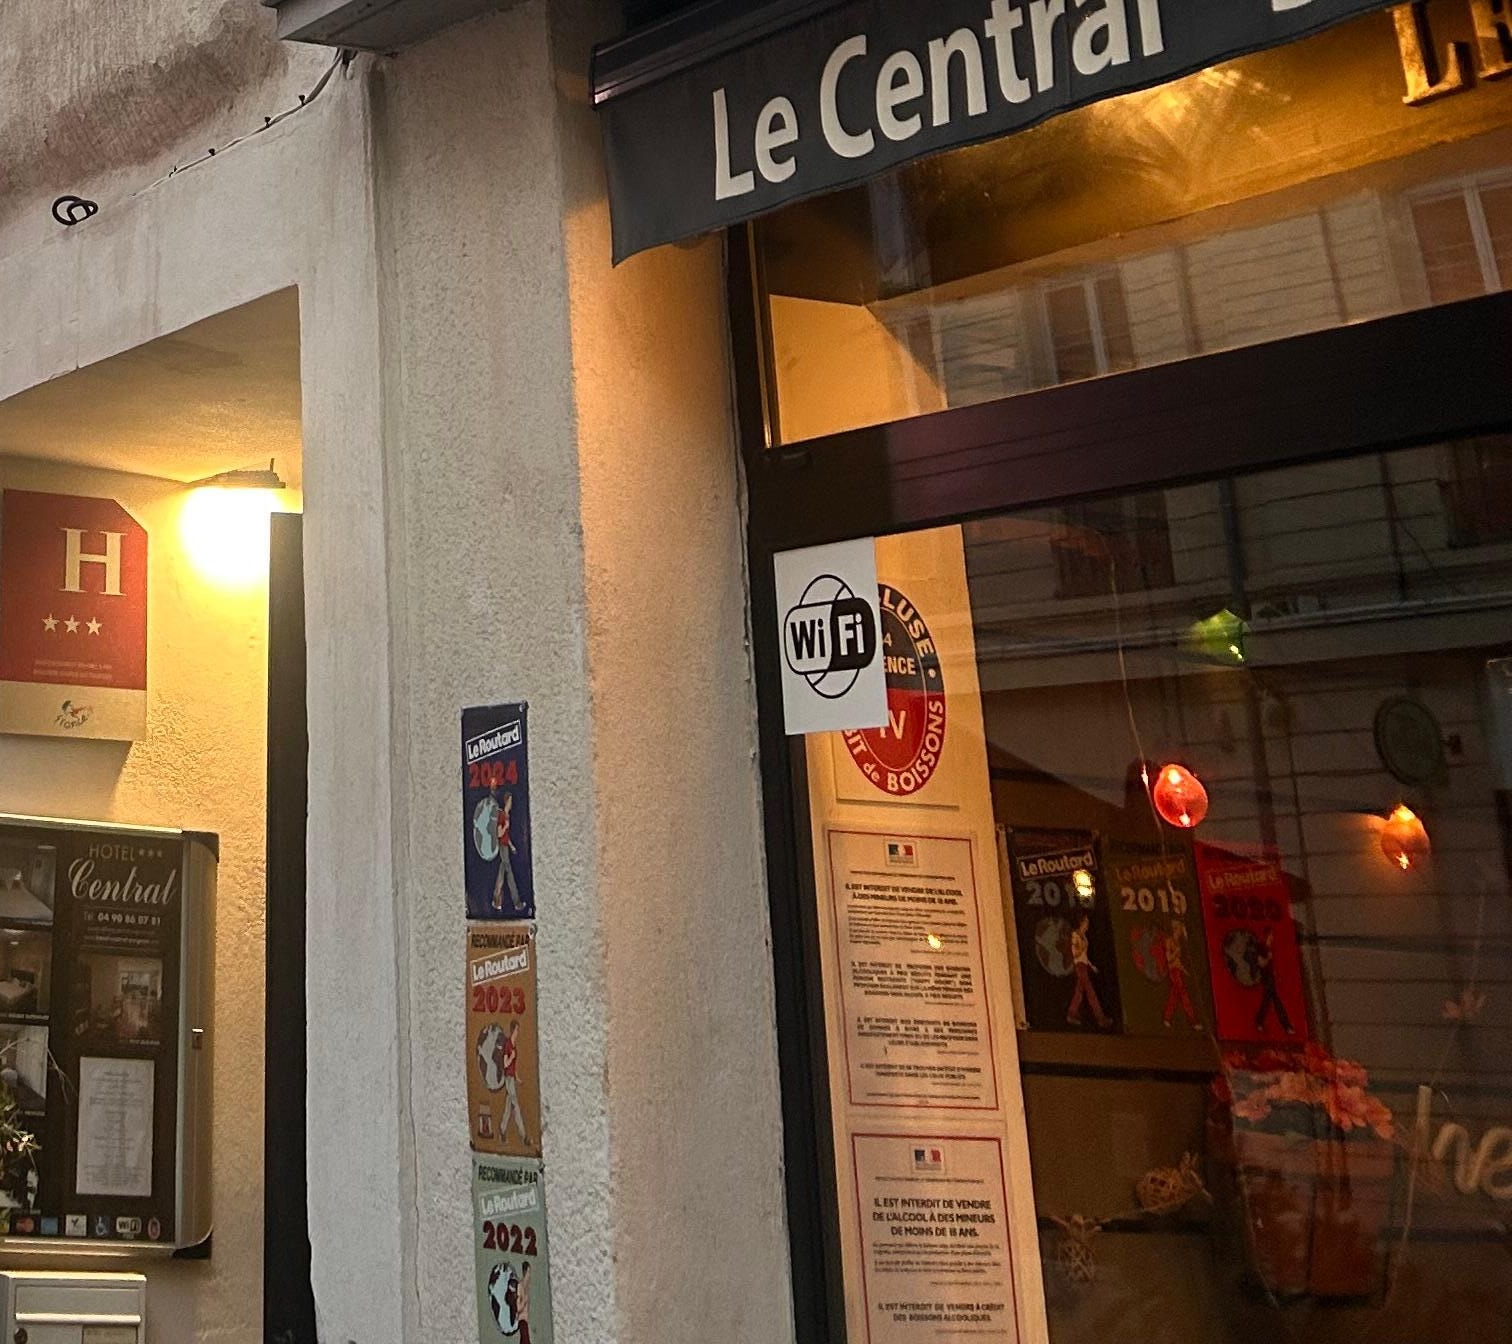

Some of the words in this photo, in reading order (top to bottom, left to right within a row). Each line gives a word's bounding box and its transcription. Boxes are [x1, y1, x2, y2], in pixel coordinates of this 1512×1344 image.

[713, 87, 798, 201] Le
[57, 526, 128, 596] H
[879, 587, 935, 658] LUSE
[467, 744, 480, 760] Le
[479, 724, 520, 755] Routard
[887, 700, 944, 793] BOISSONS
[469, 760, 519, 789] 2024
[88, 843, 135, 861] HOTEL
[1020, 859, 1038, 877] Le
[1037, 851, 1094, 875] Routard
[68, 857, 178, 905] Central
[1120, 887, 1188, 914] 2019
[472, 964, 485, 981] Le
[484, 949, 527, 978] Routard
[472, 985, 526, 1015] 2023
[481, 1197, 494, 1216] Le
[493, 1188, 537, 1213] Routard
[883, 1198, 899, 1209] EST
[900, 1198, 941, 1210] INTERDIT
[942, 1199, 954, 1210] DE
[955, 1200, 992, 1210] VENDRE
[872, 1212, 885, 1223] DE
[938, 1213, 955, 1224] DES
[955, 1213, 996, 1224] MINEURS
[890, 1226, 904, 1237] DE
[904, 1226, 934, 1237] MOINS
[934, 1227, 948, 1237] DE
[482, 1220, 538, 1257] 2022
